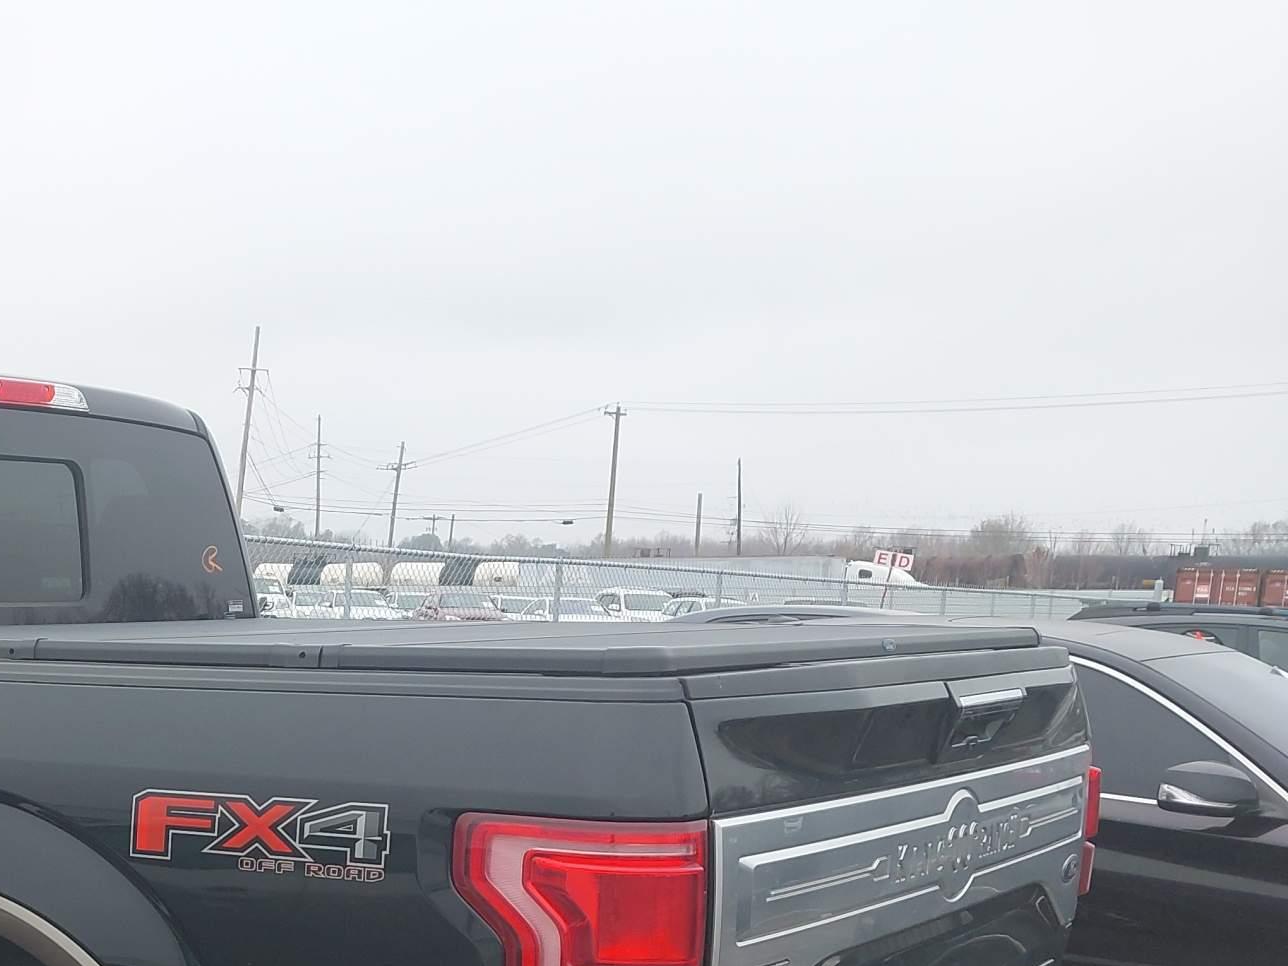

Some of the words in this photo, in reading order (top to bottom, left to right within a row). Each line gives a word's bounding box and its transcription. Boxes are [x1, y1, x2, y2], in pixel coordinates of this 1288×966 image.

[130, 789, 390, 868] FX4
[238, 856, 295, 874] OFF
[304, 862, 386, 883] ROAD
